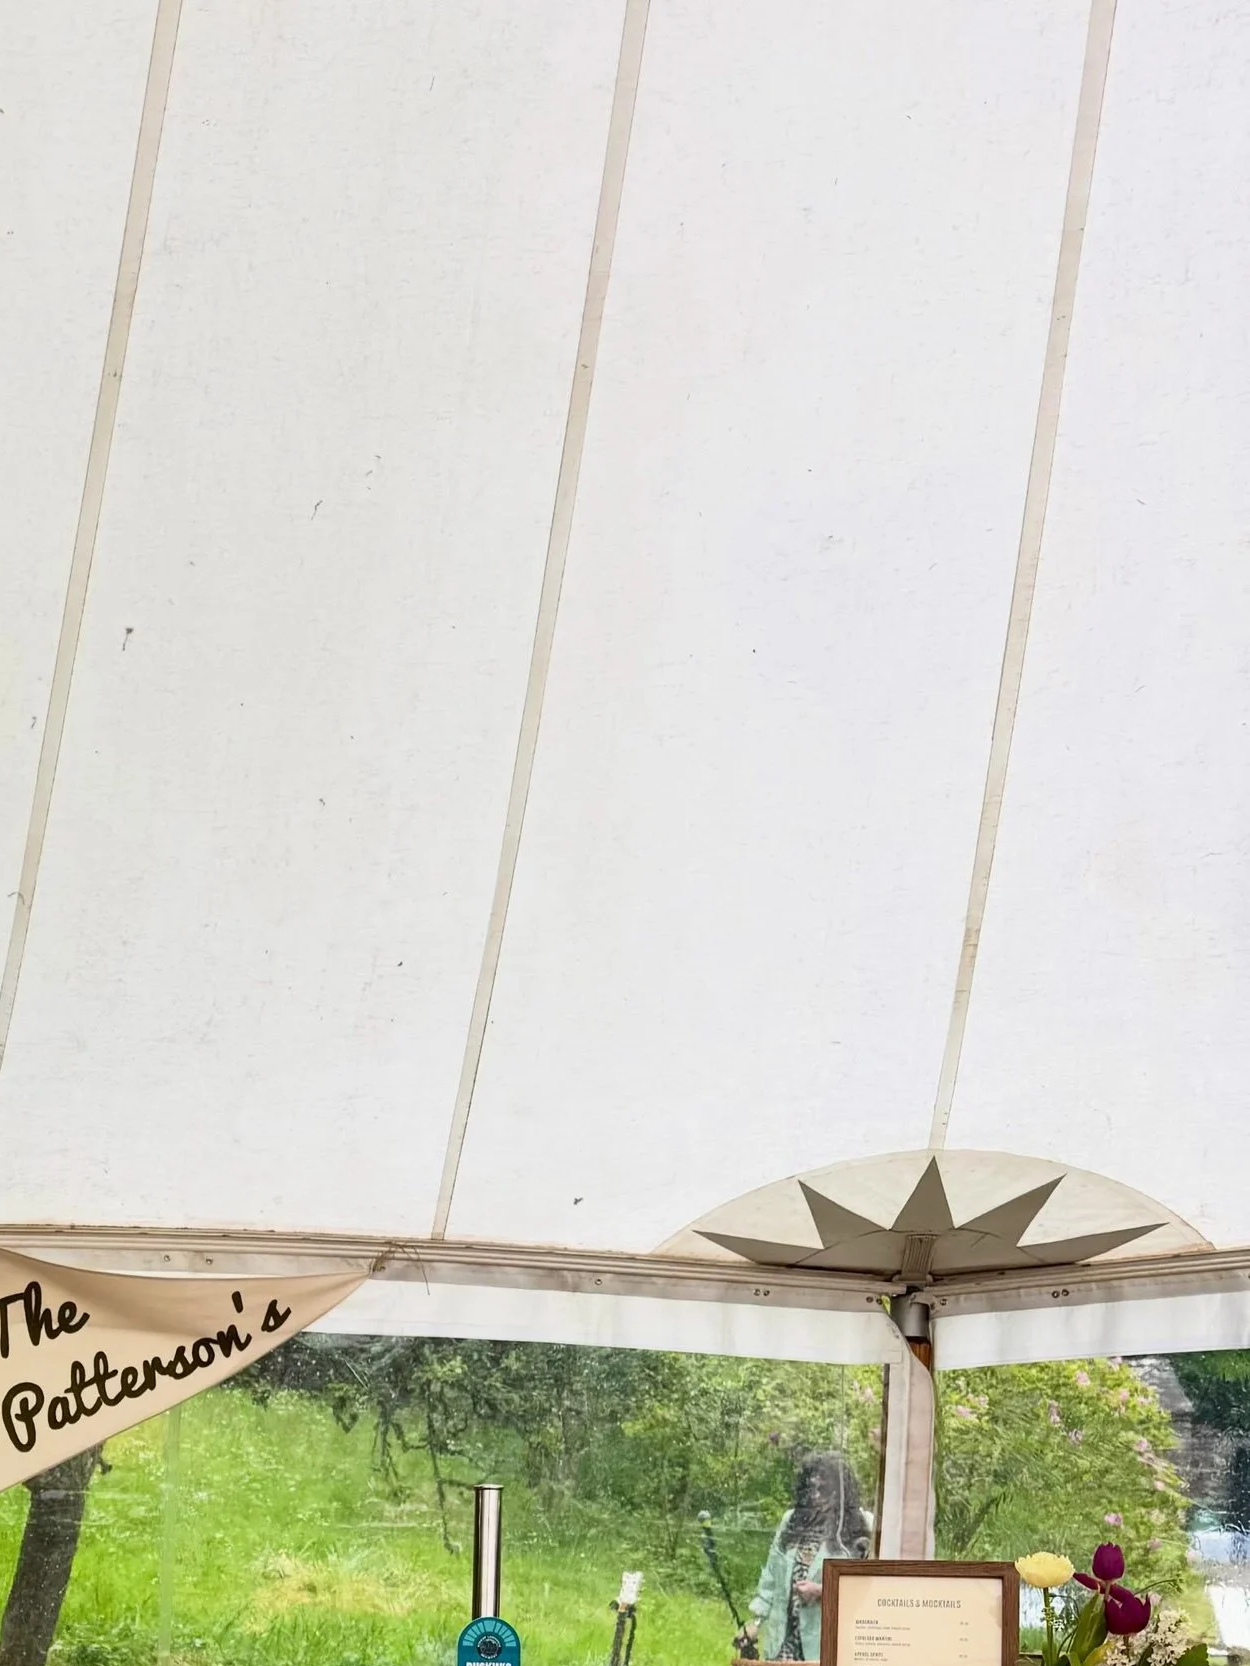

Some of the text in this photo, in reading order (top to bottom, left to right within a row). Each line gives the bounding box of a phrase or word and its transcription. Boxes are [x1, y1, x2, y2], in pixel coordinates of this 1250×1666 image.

[1, 1291, 291, 1452] Patterson's
[877, 1598, 914, 1608] COCKTAILS
[922, 1599, 962, 1609] MOCKTAILS
